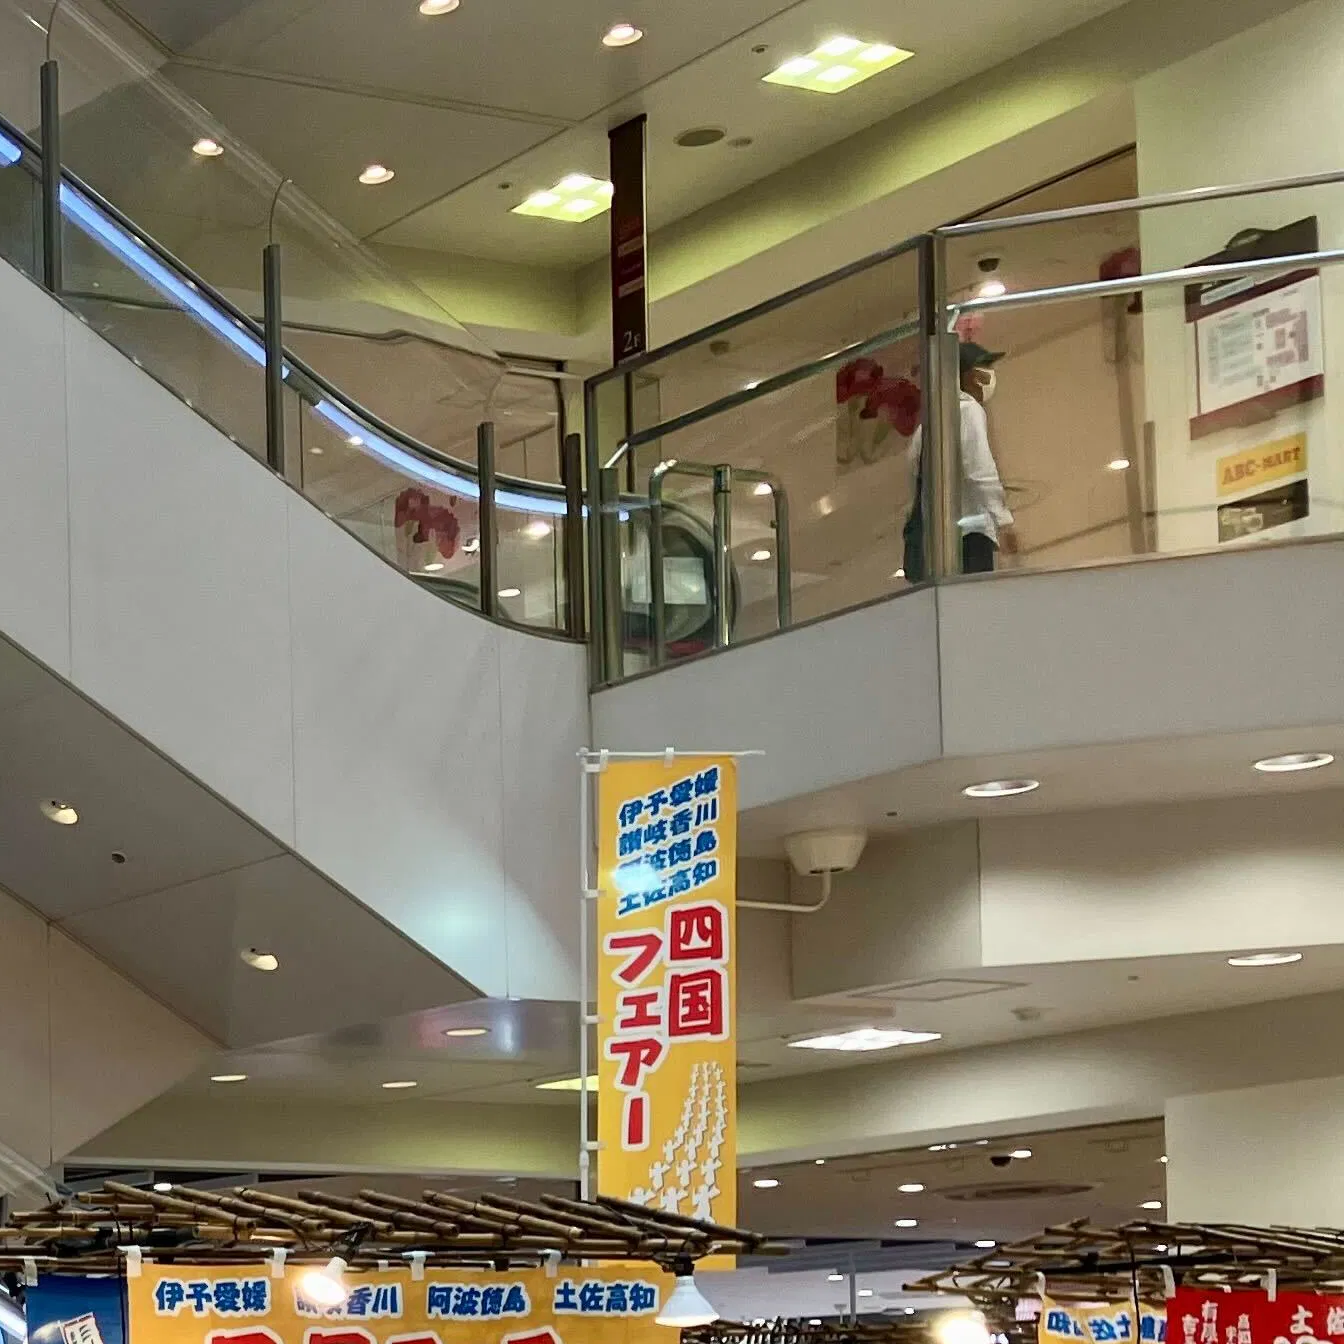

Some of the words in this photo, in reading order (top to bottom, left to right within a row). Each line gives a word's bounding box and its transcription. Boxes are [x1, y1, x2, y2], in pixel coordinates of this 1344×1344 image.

[620, 767, 719, 826] 伊予愛媛
[619, 799, 717, 857] 讃岐香川
[619, 832, 717, 882] 波徳島
[669, 907, 723, 1035] 四国
[610, 933, 663, 1146] フェアー
[156, 1281, 267, 1312] 伊予愛媛
[428, 1285, 527, 1315] 阿波徳島
[555, 1282, 656, 1312] 土佐高知
